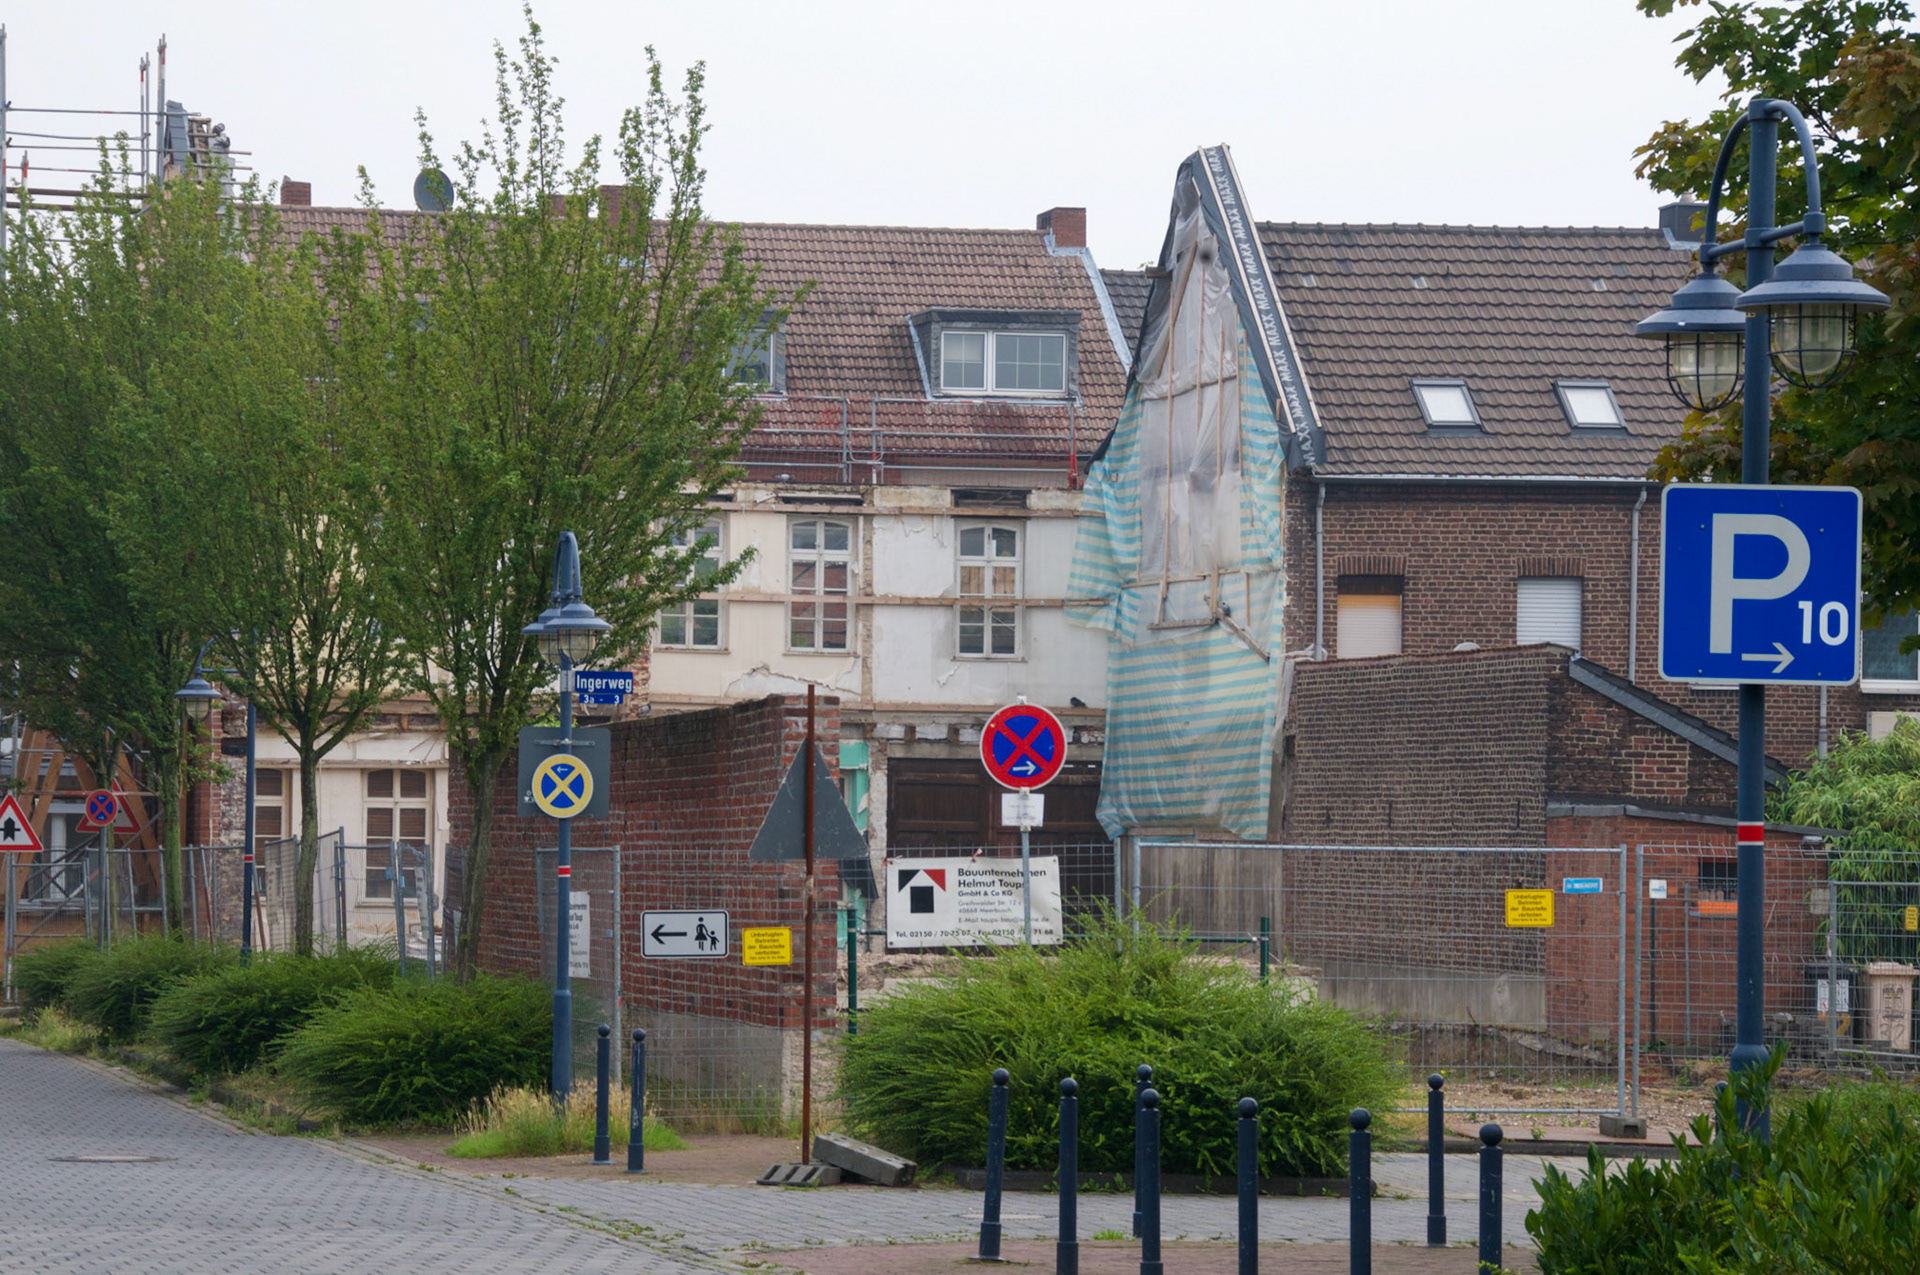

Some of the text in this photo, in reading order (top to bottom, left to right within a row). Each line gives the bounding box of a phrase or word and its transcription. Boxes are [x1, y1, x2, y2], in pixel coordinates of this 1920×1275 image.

[1215, 174, 1236, 205] MAXX
[1227, 208, 1248, 239] MAXX
[1239, 243, 1260, 274] MAXX
[1250, 278, 1271, 310] MAXX
[1261, 313, 1282, 346] MAXX
[1273, 350, 1293, 382] MAXX
[1285, 386, 1305, 418] MAXX
[1709, 512, 1811, 654] P
[1798, 600, 1849, 646] 10
[576, 674, 633, 693] Ingerweg
[583, 694, 595, 704] 3a
[613, 694, 620, 705] 3
[957, 879, 996, 888] Helmut
[909, 930, 933, 938] 02150
